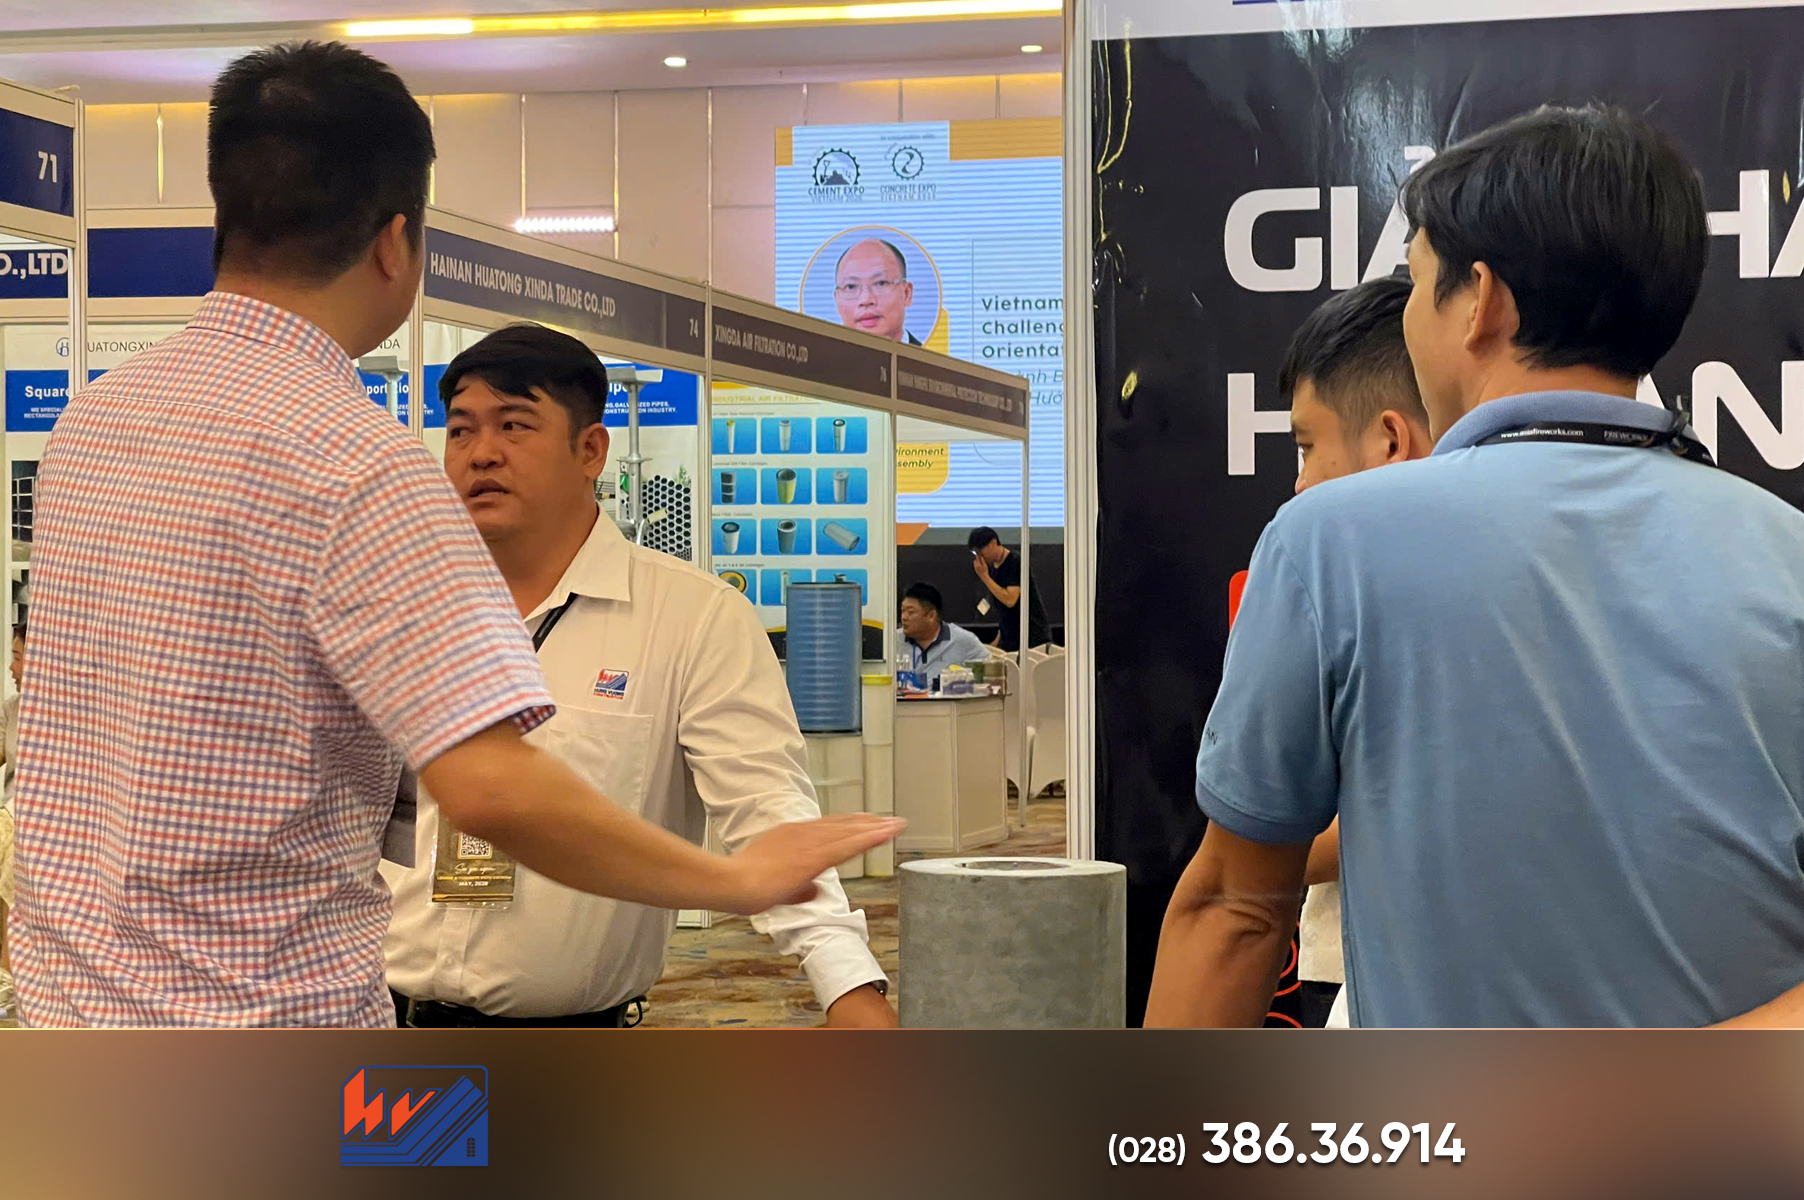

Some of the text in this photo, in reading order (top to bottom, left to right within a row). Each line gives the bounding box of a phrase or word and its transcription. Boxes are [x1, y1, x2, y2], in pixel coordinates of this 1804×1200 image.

[38, 151, 58, 183] 71
[808, 186, 865, 196] CEMENT EXPO
[431, 252, 616, 319] HAINAN HUATONG XINDA TRADE CO.,LTD
[982, 295, 1063, 311] Vietnam
[689, 318, 699, 338] 74
[715, 324, 741, 347] XINGDA
[742, 332, 753, 350] AIR
[754, 335, 786, 357] FILTRATION
[982, 342, 1063, 358] Orienta
